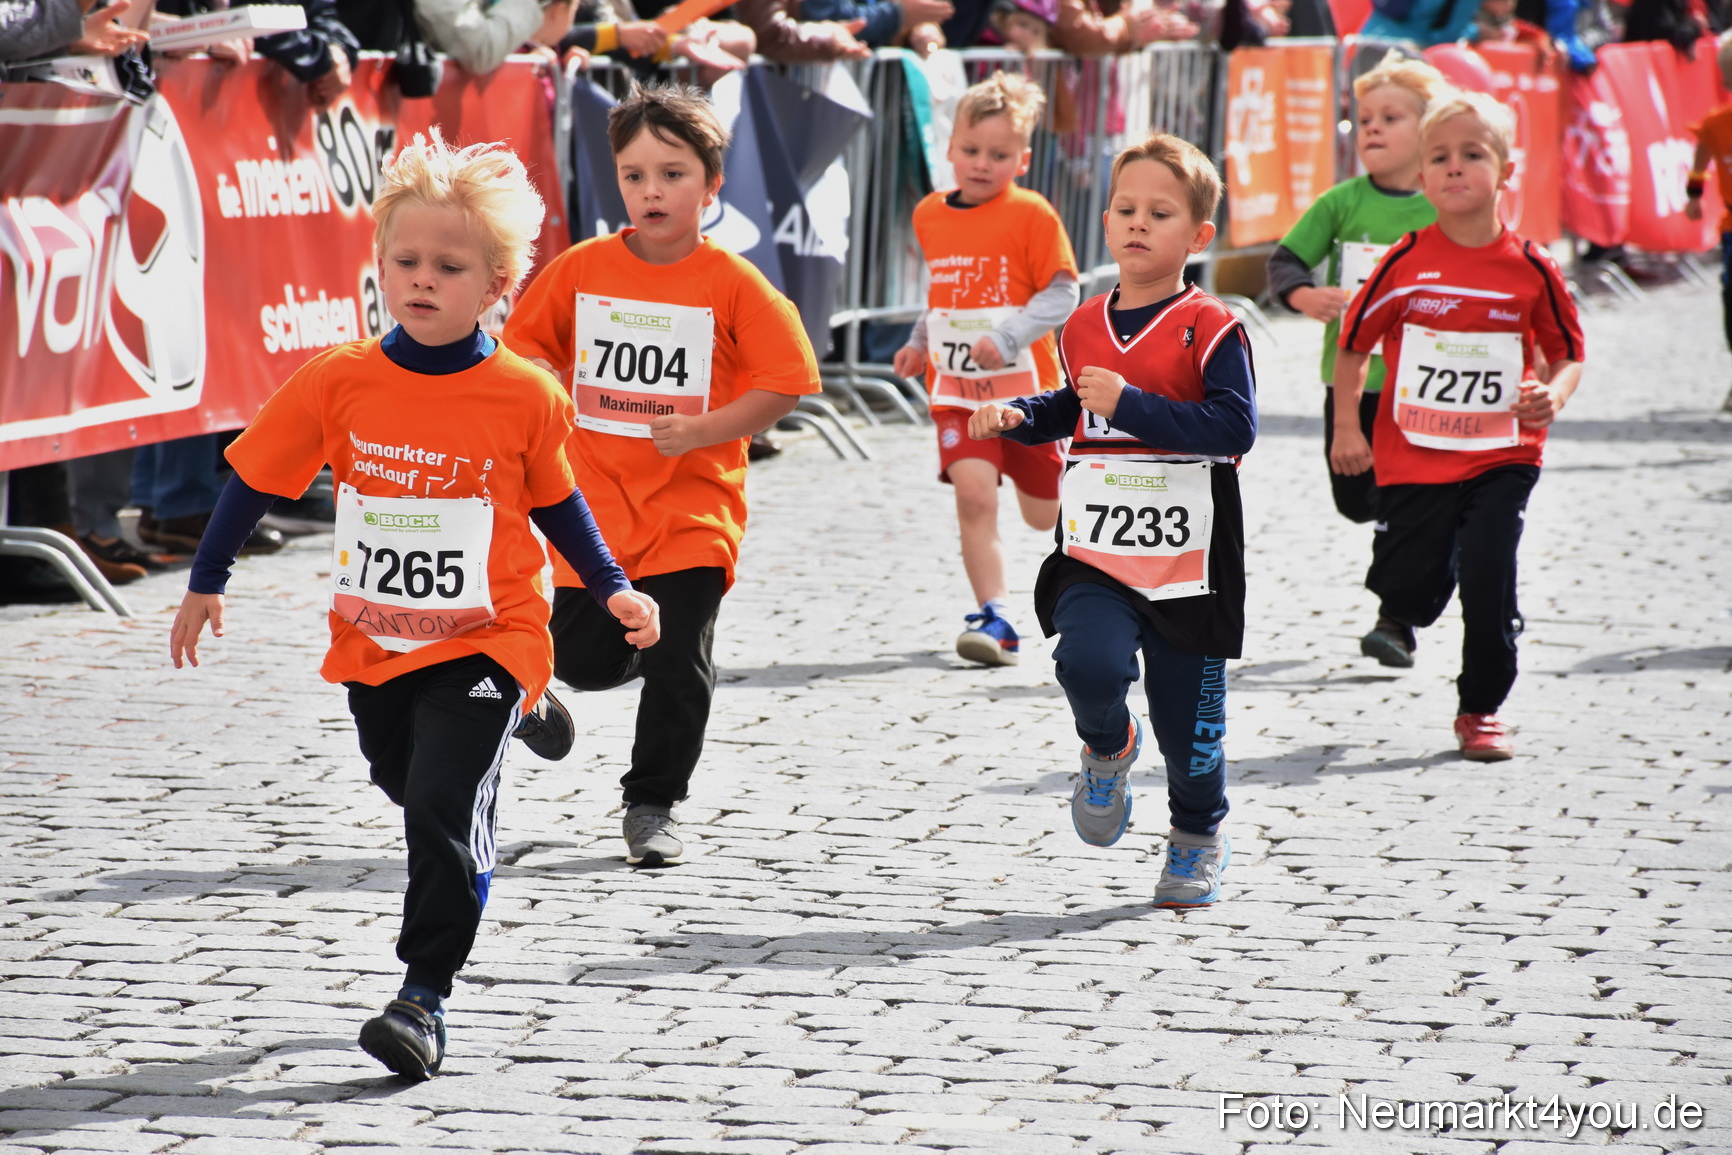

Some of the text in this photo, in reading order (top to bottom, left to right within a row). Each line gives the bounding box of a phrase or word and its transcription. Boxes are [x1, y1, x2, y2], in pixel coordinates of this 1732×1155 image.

[623, 312, 671, 328] BOCK
[594, 338, 688, 387] 7004
[1446, 344, 1488, 356] BOCK
[1417, 364, 1502, 405] 7275
[600, 394, 674, 416] Maximilian
[1405, 408, 1484, 436] MICHAEL
[349, 430, 447, 467] Neumarkter
[1118, 474, 1167, 487] BOCK
[380, 513, 440, 528] BOCK
[1085, 504, 1190, 548] 7233
[357, 540, 465, 599] 7265
[353, 605, 458, 636] ANTON
[468, 687, 502, 699] adidas
